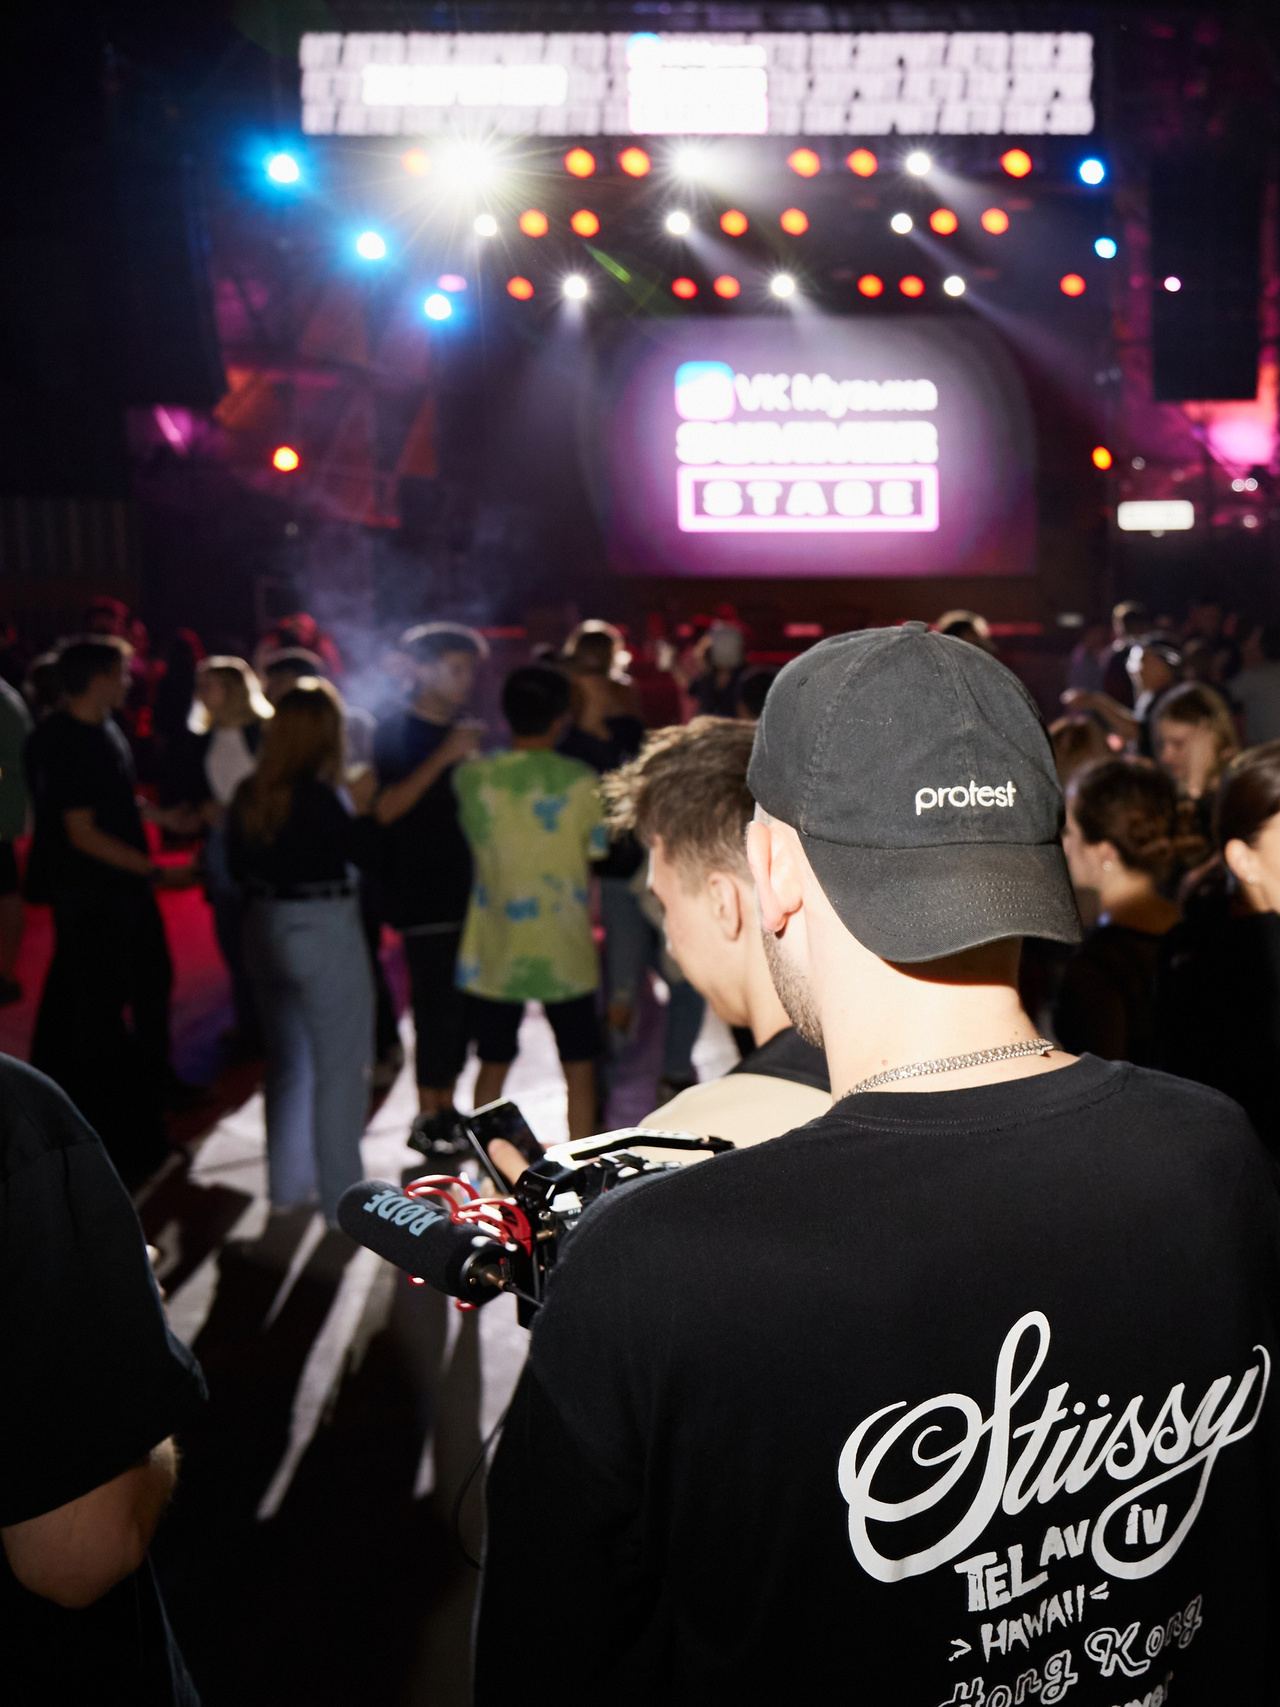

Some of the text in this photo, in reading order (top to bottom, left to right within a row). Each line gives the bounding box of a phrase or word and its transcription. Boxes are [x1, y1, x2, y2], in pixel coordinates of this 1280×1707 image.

[915, 780, 1017, 816] protest
[954, 1543, 1049, 1612] TEL
[981, 1584, 1086, 1663] HAWAII
[1084, 1594, 1203, 1677] Kong
